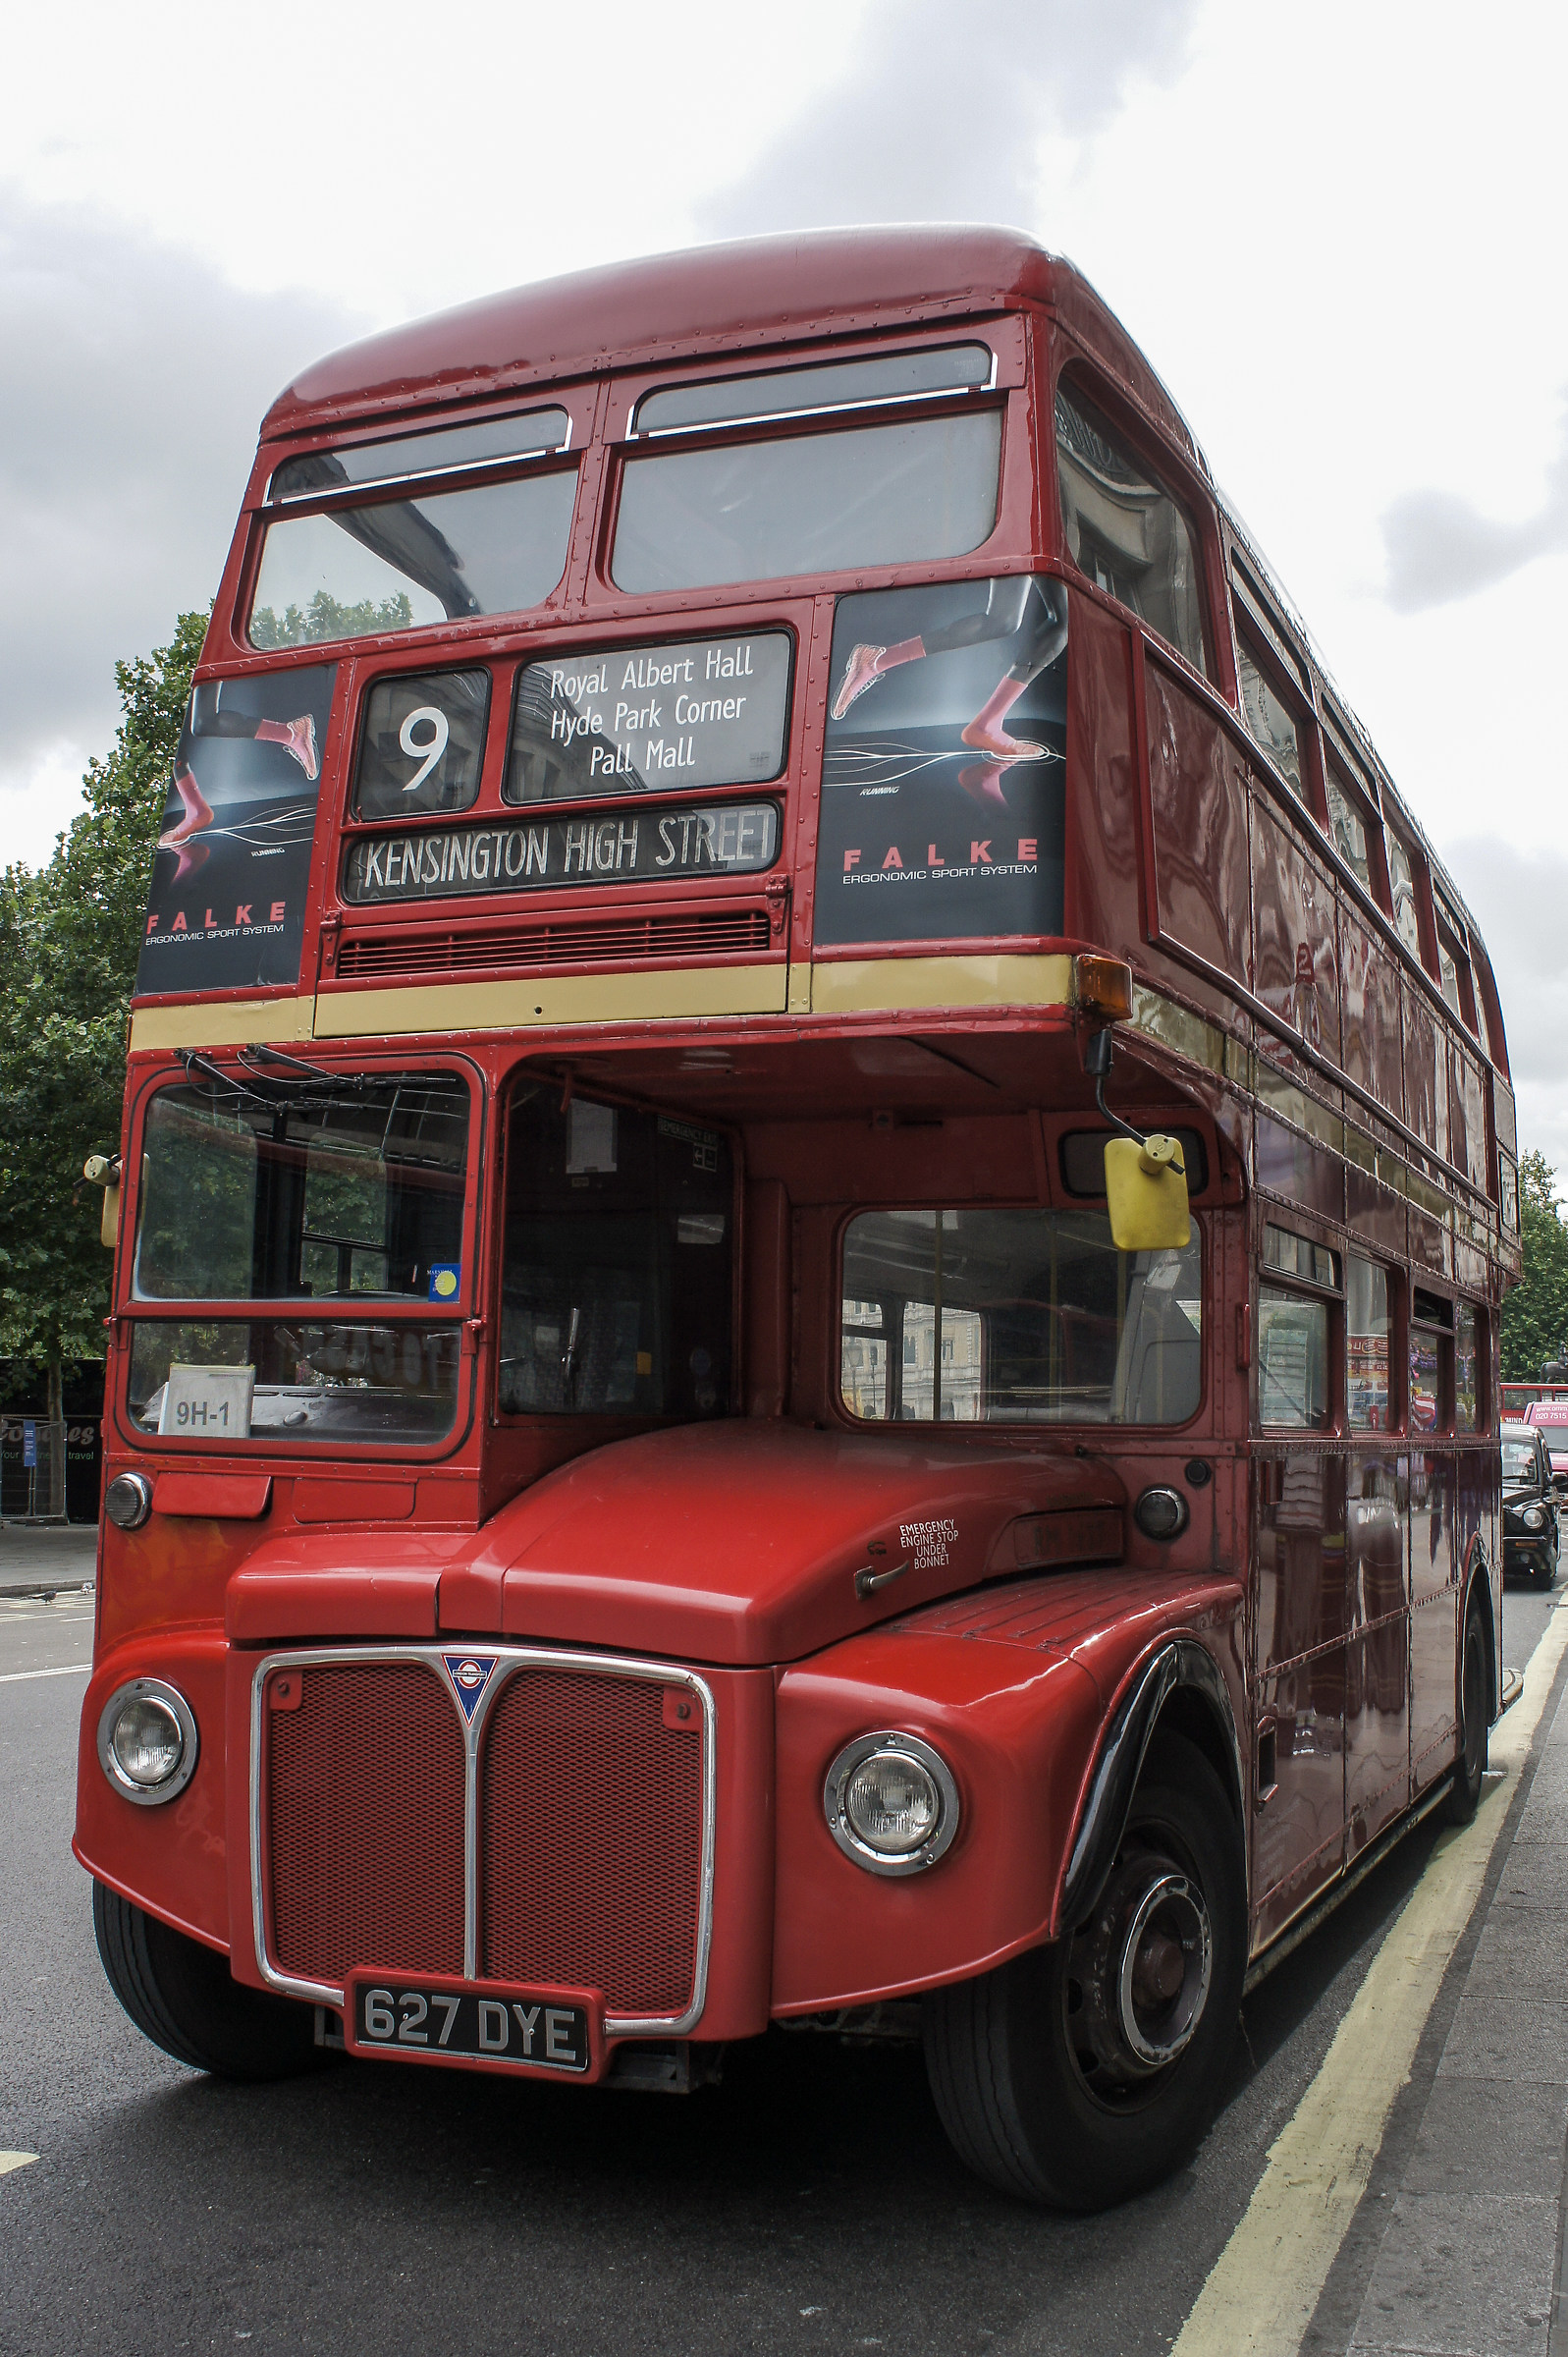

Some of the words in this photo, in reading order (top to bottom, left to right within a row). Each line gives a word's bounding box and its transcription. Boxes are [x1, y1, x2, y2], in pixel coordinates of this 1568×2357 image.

[551, 664, 609, 705] Royal
[621, 658, 694, 690] Albert
[705, 645, 753, 680] Hall
[551, 706, 603, 747] Hyde
[614, 698, 663, 732] Park
[675, 694, 747, 725] Corner
[399, 706, 449, 792] 9
[590, 742, 633, 777] Pall
[645, 736, 696, 770] Mall
[859, 786, 900, 796] RUNNING
[251, 847, 285, 857] RUNNING
[364, 826, 550, 888] KENSINGTON
[564, 819, 639, 873] HIGH
[655, 808, 776, 867] STREET
[843, 838, 1038, 872] FALKE
[842, 870, 927, 885] ERGONOMIC
[932, 867, 977, 879] SPORT
[980, 864, 1038, 876] SYSTEM
[146, 901, 286, 935] FALKE
[145, 931, 204, 946] ERGONOMIC
[207, 928, 241, 939] SPORT
[242, 924, 285, 936] SYSTEM
[178, 1401, 229, 1426] 9H-1
[68, 1451, 94, 1460] travel
[899, 1518, 955, 1537] EMERGENCY
[900, 1532, 935, 1549] ENGINE
[937, 1529, 959, 1544] STOP
[914, 1553, 949, 1569] BONNET
[916, 1543, 947, 1558] UNDER
[364, 1989, 461, 2046] 627
[478, 2000, 576, 2061] DYE
